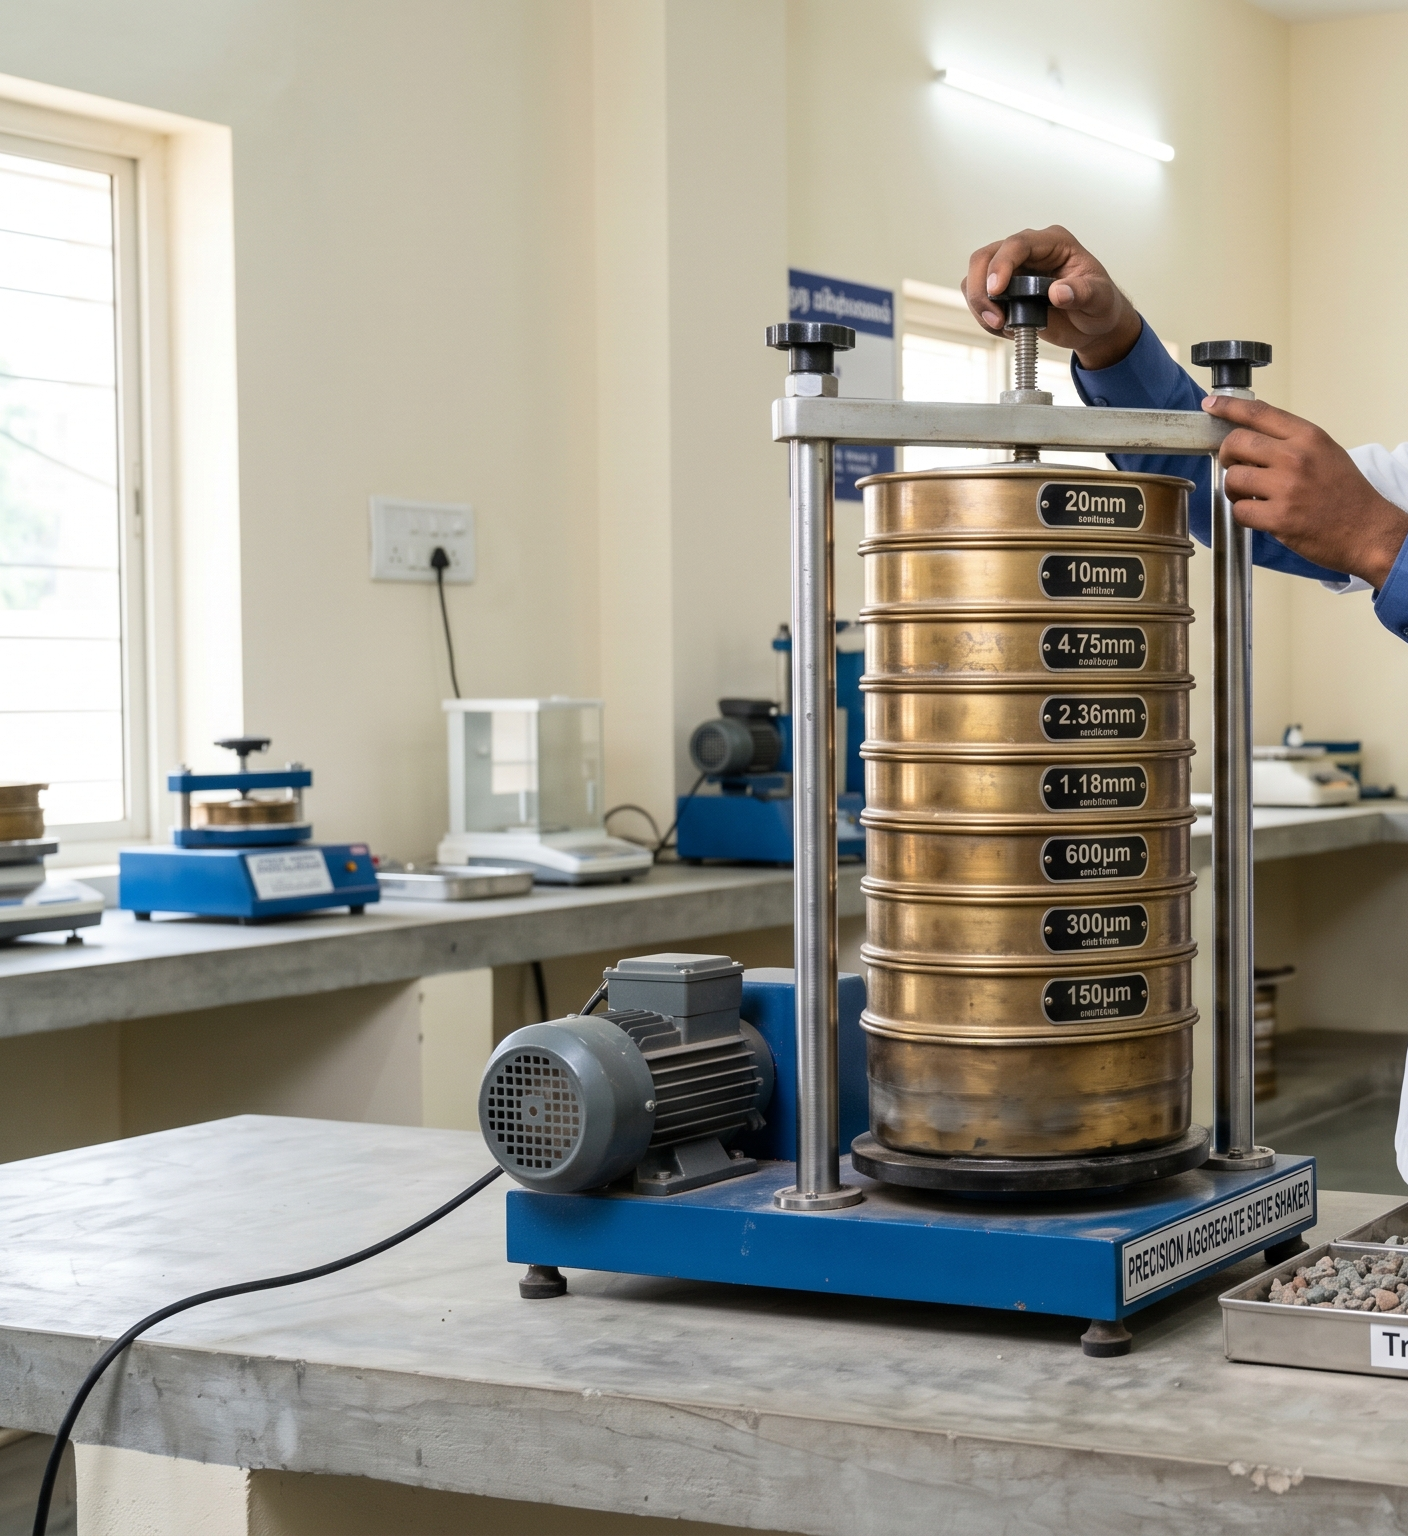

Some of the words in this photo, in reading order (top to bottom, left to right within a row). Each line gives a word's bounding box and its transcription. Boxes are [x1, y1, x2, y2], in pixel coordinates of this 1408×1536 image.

[1065, 490, 1126, 513] 20mm
[1067, 561, 1127, 583] 10mm
[1057, 633, 1135, 654] 4.75mm
[1058, 704, 1136, 725] 2.36mm
[1059, 773, 1136, 794] 1.18mm
[1065, 843, 1131, 867] 600µm
[1066, 913, 1131, 937] 300µm
[1067, 983, 1131, 1007] 150µm
[1128, 1234, 1184, 1288] PRECISION
[1186, 1207, 1245, 1261] AGGREGATE
[1247, 1197, 1273, 1233] SIEVE
[1274, 1180, 1310, 1220] SHAKER
